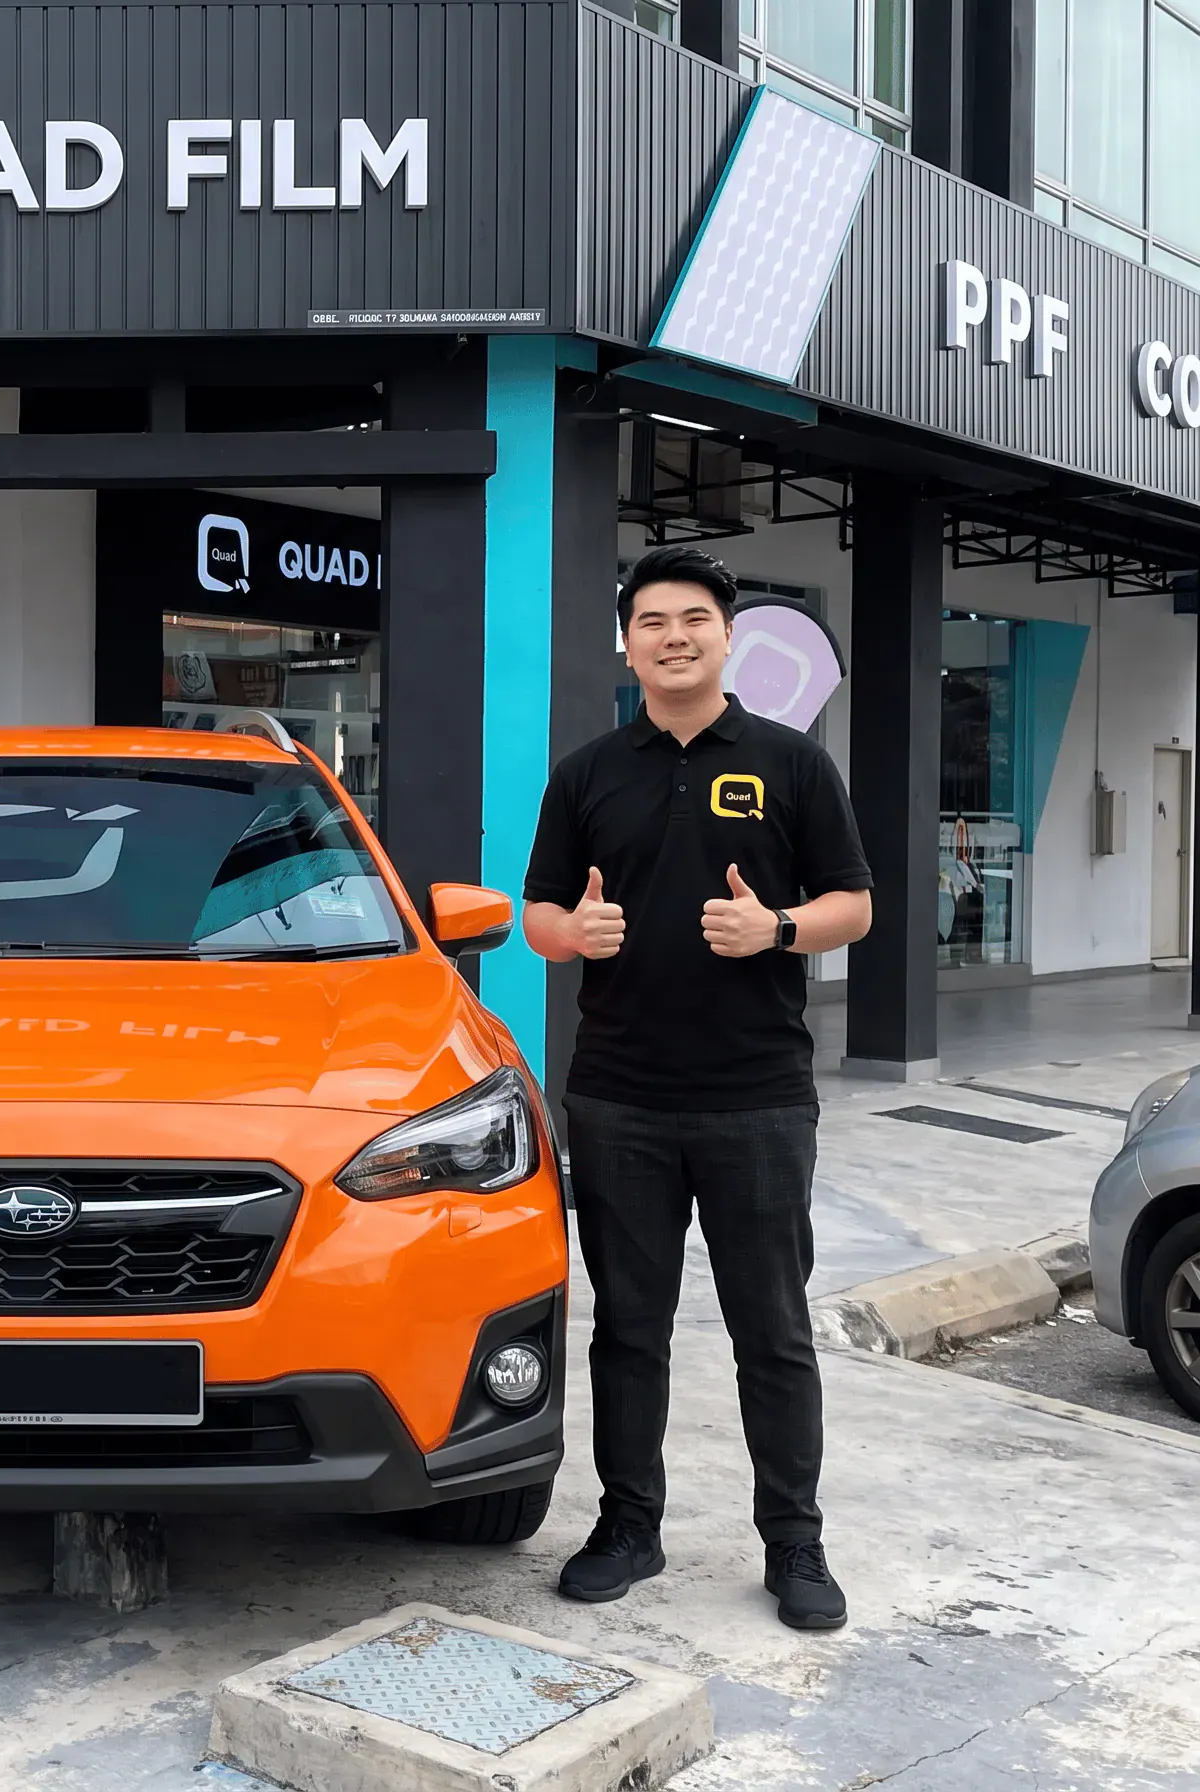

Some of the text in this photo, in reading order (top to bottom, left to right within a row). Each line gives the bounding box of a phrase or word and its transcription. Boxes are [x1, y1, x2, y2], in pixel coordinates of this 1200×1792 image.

[166, 118, 429, 211] FILM
[946, 259, 1070, 378] PPF
[1138, 340, 1200, 429] CO
[211, 547, 237, 562] Quad
[278, 540, 370, 587] QUAD
